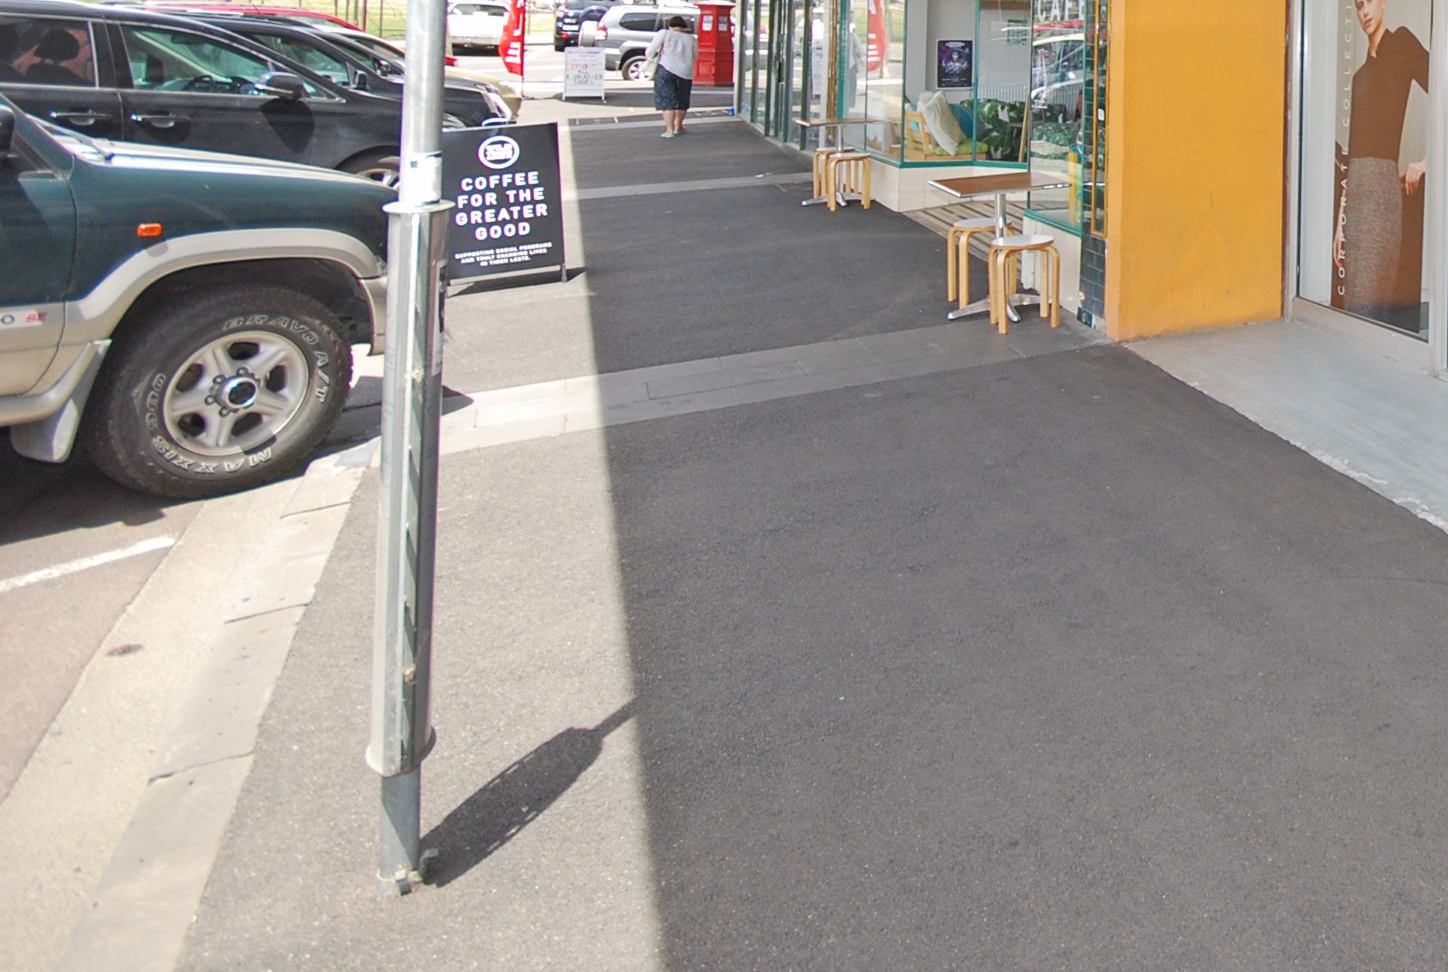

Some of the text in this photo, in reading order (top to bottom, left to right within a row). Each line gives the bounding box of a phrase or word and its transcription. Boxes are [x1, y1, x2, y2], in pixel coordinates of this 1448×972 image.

[461, 170, 540, 192] COFFEE
[456, 186, 545, 210] FOR THE
[455, 202, 549, 227] GREATER
[1337, 146, 1349, 296] CORPORATE
[474, 221, 531, 241] GOOD
[222, 314, 320, 346] BRAVO
[151, 435, 273, 475] MAXXIS
